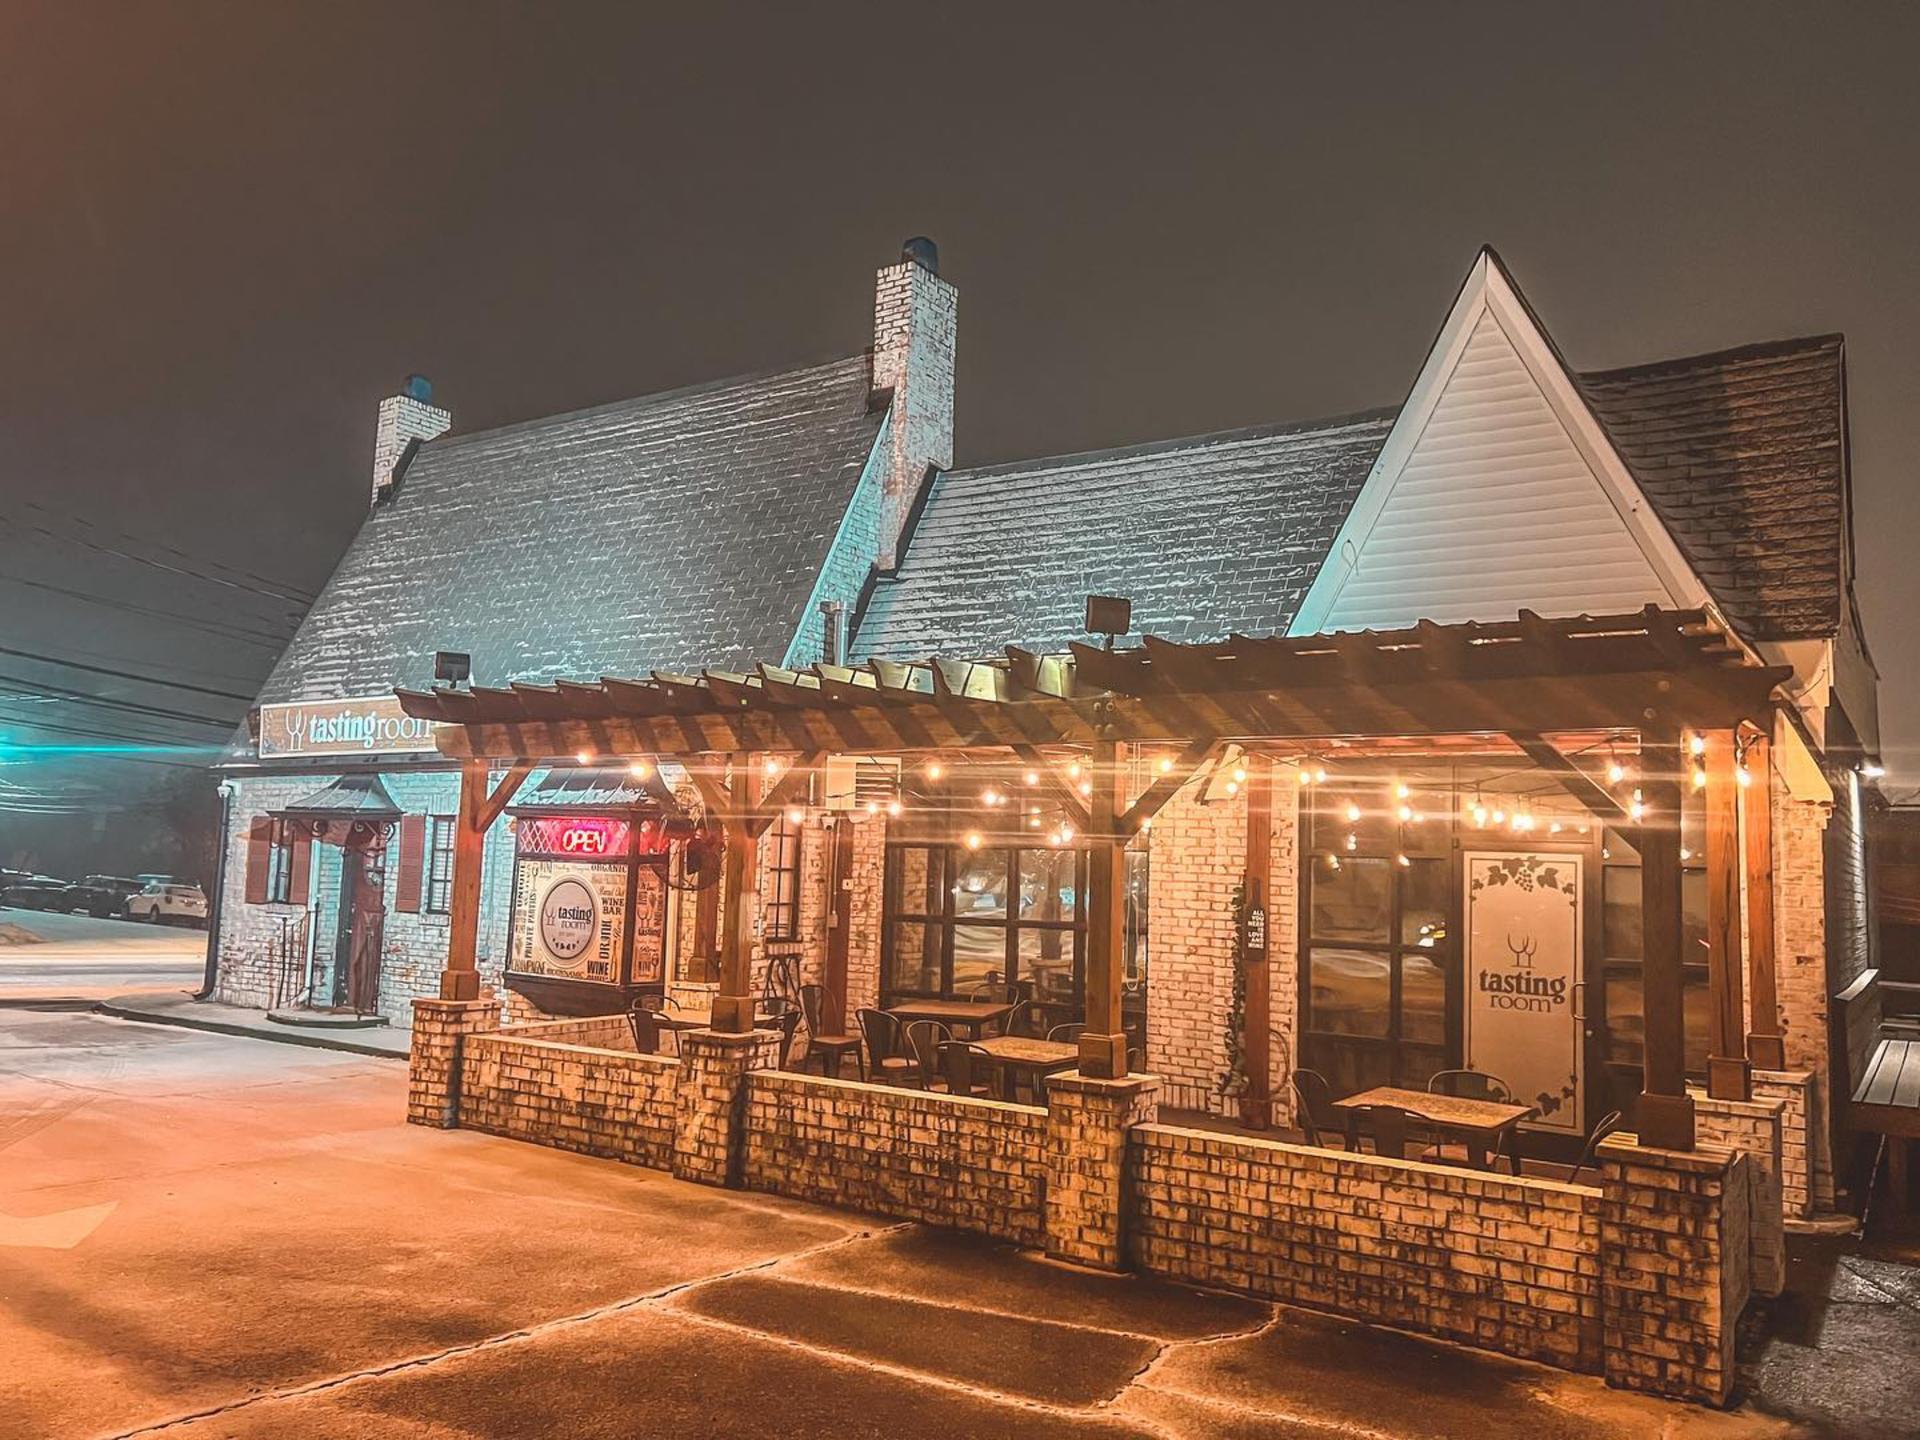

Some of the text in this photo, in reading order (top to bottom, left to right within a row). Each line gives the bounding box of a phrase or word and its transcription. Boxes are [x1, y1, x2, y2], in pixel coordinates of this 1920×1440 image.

[562, 828, 608, 853] OPEN
[601, 897, 625, 907] WINE
[558, 906, 593, 924] tasting
[602, 906, 622, 916] BAR
[561, 920, 586, 930] room
[587, 960, 609, 975] WINE
[1479, 969, 1566, 1005] tasting
[1490, 995, 1551, 1013] room
